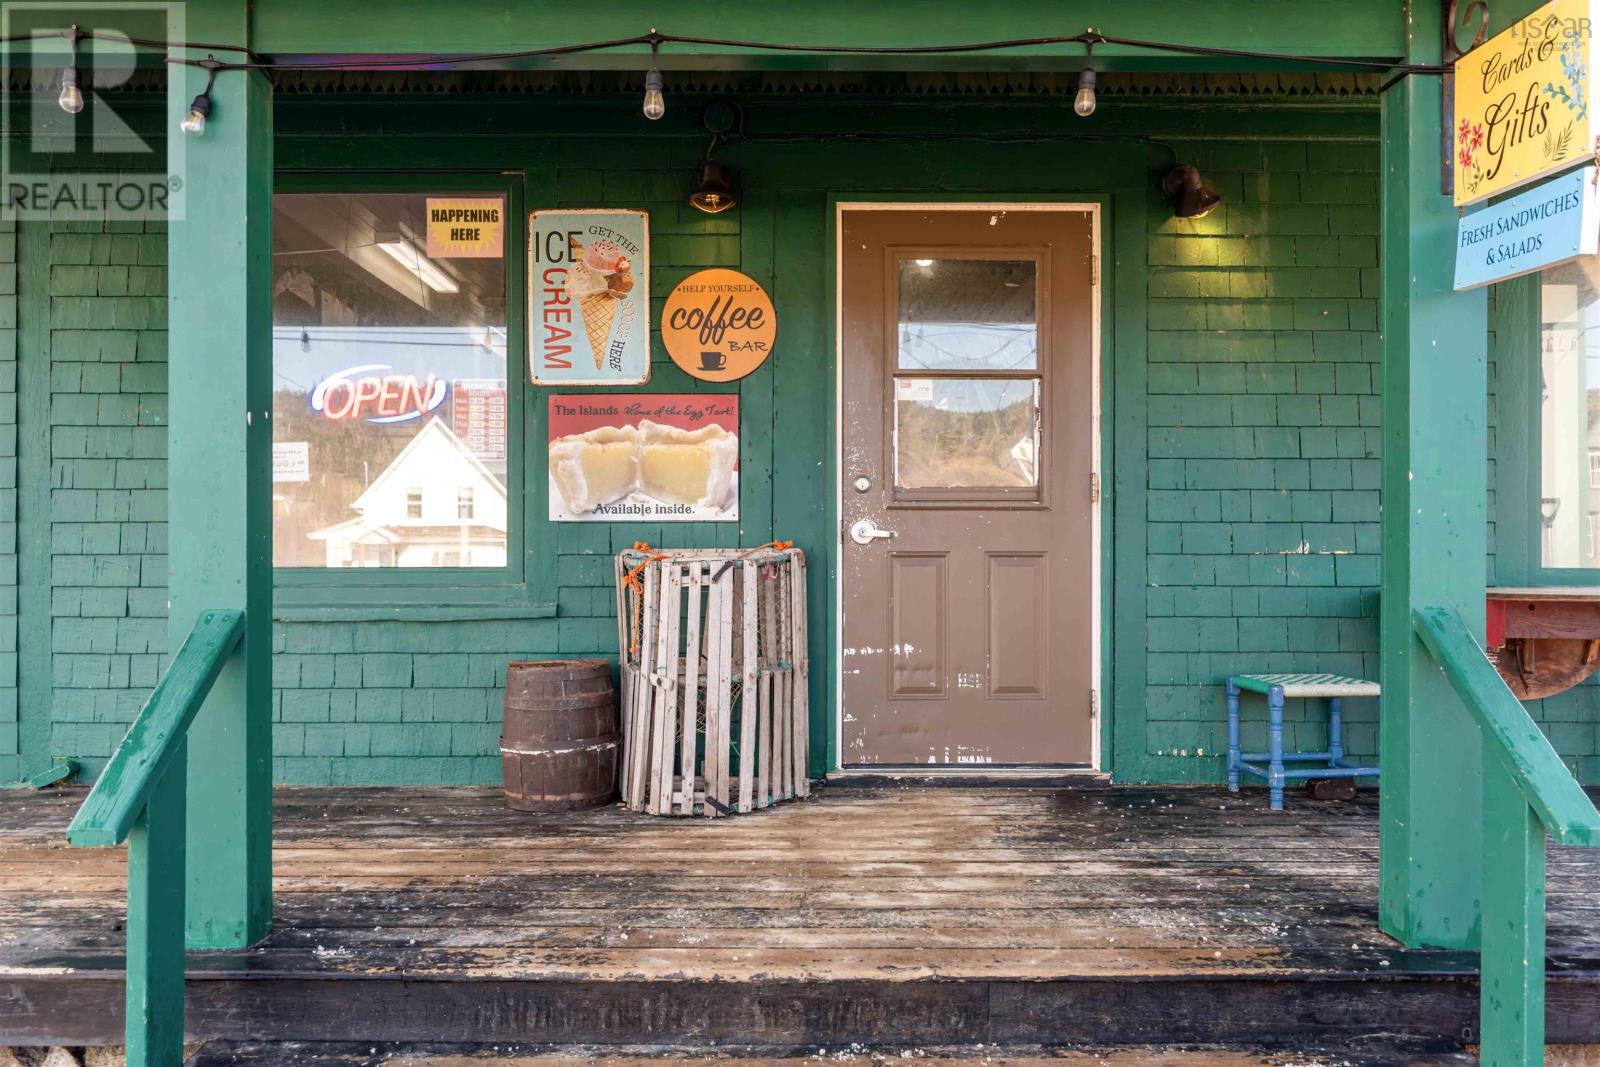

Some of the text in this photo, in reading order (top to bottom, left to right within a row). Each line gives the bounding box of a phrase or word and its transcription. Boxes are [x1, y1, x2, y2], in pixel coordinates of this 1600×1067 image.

[1481, 38, 1534, 94] Cards
[1484, 81, 1550, 180] Gifts
[431, 209, 499, 223] HAPPENING
[1460, 190, 1579, 248] FRESH SANDWICHES
[450, 228, 480, 241] HERE
[535, 230, 584, 264] ICE
[588, 225, 640, 256] GET THE
[1486, 233, 1543, 266] & SALADS
[682, 284, 755, 293] HELP YOURSELF
[542, 267, 573, 369] CREAM
[670, 295, 765, 346] coffee
[609, 339, 626, 372] HERE
[727, 340, 769, 352] BAR
[323, 373, 437, 419] OPEN
[554, 403, 735, 421] The Islands Home of the Egg Tart!
[592, 503, 695, 516] Available inside.
